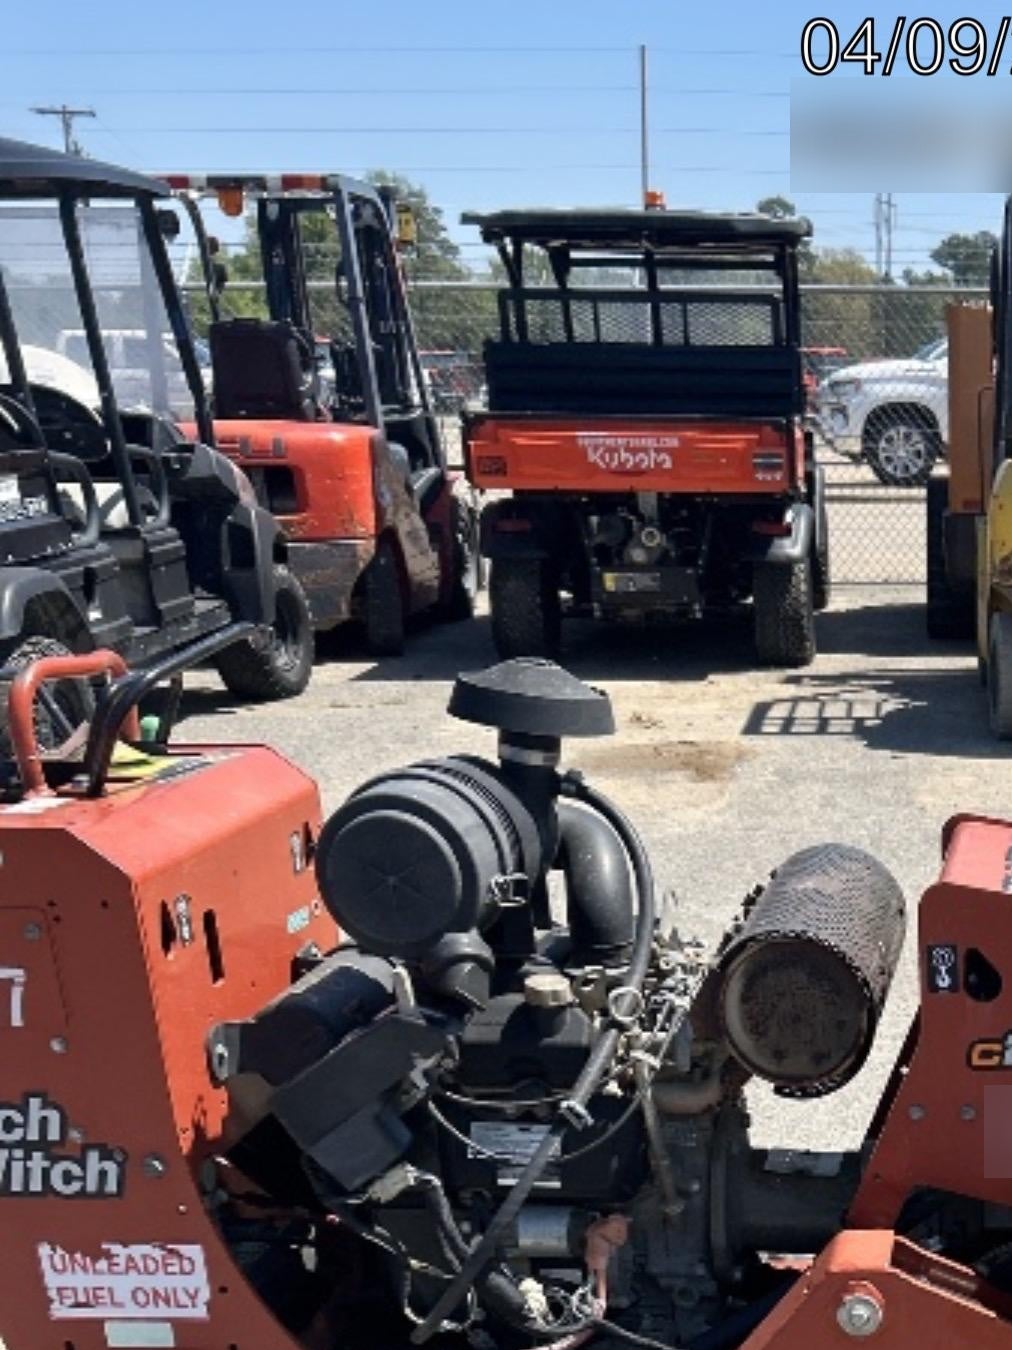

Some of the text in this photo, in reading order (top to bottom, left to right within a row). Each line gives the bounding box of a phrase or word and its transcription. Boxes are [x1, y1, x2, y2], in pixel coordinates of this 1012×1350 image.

[587, 447, 672, 469] Kubota
[0, 1148, 119, 1195] itch
[51, 1252, 196, 1276] UNLEADED
[56, 1286, 200, 1308] FUEL ONLY
